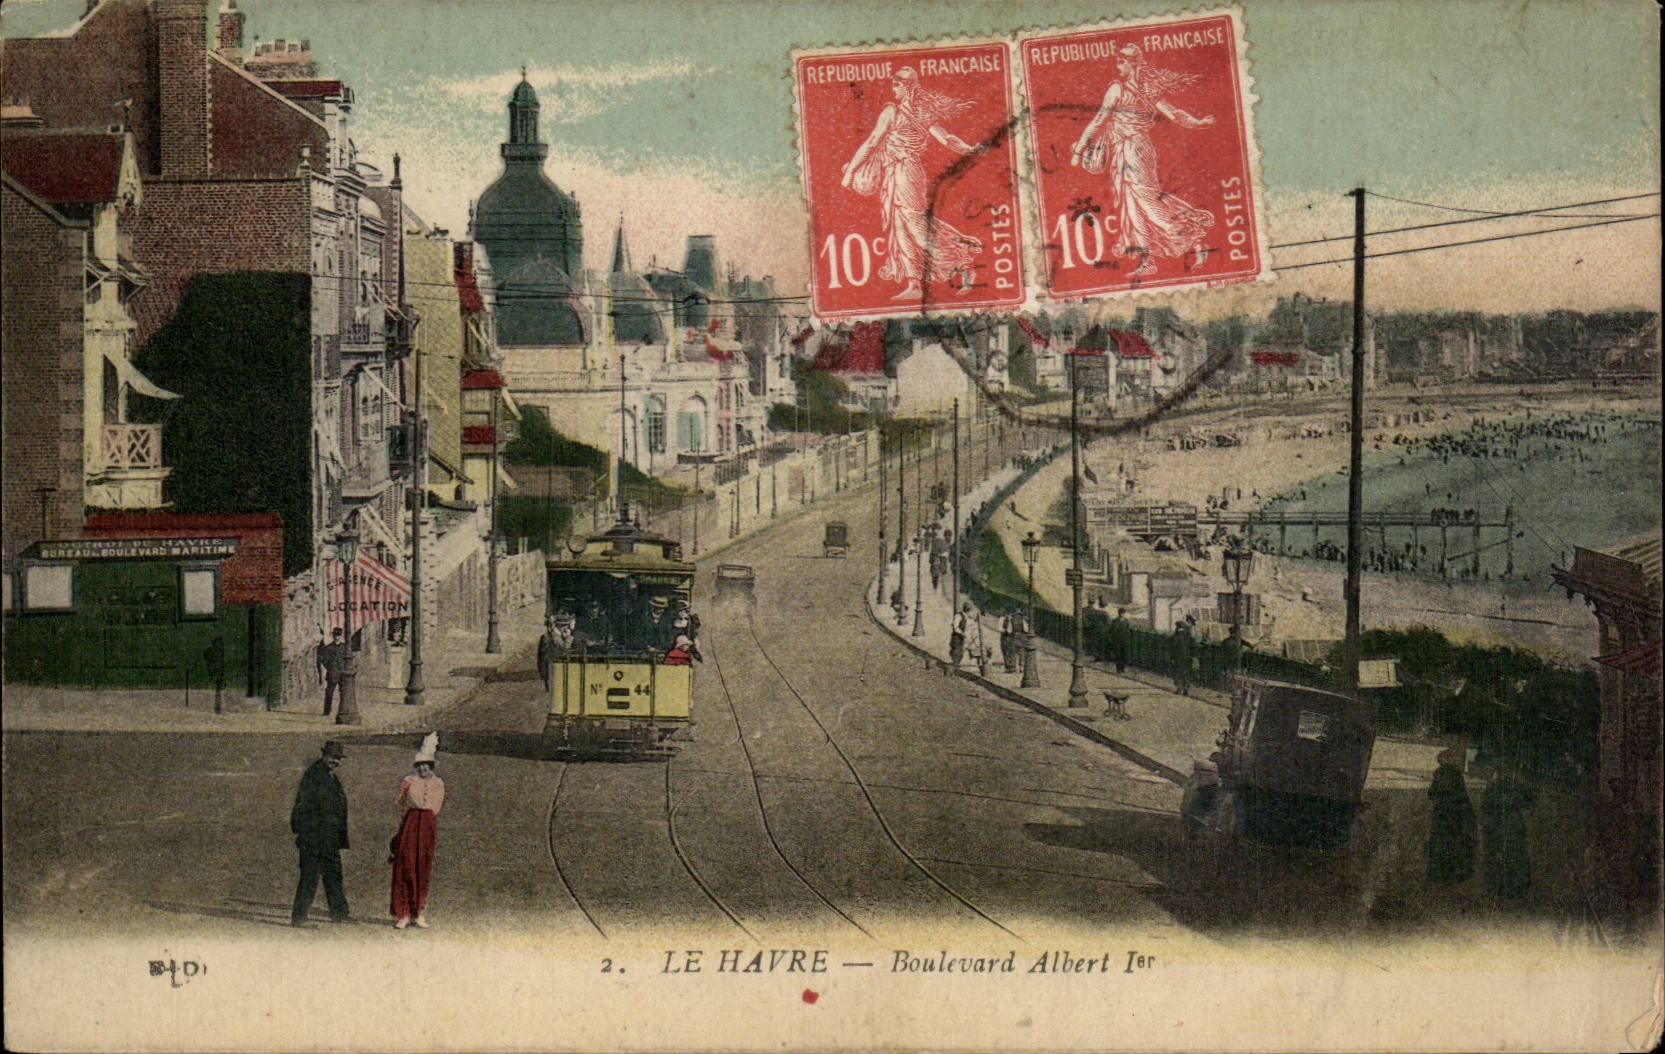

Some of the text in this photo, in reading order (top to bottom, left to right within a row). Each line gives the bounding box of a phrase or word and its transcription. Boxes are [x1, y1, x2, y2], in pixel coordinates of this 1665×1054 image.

[1031, 27, 1224, 66] REPUBLIQUE FRANÇAISE
[807, 54, 1000, 84] REPUBLIQUE FRANÇAISE
[1221, 176, 1249, 261] POSTES
[990, 204, 1014, 289] POSTES
[162, 538, 222, 547] HAVRE
[41, 549, 90, 558] BUREAU
[101, 547, 166, 558] BOULEVARD
[171, 545, 236, 555] MARITIME
[339, 574, 383, 591] AENCE
[327, 601, 408, 612] LOCATION
[634, 684, 651, 696] 44
